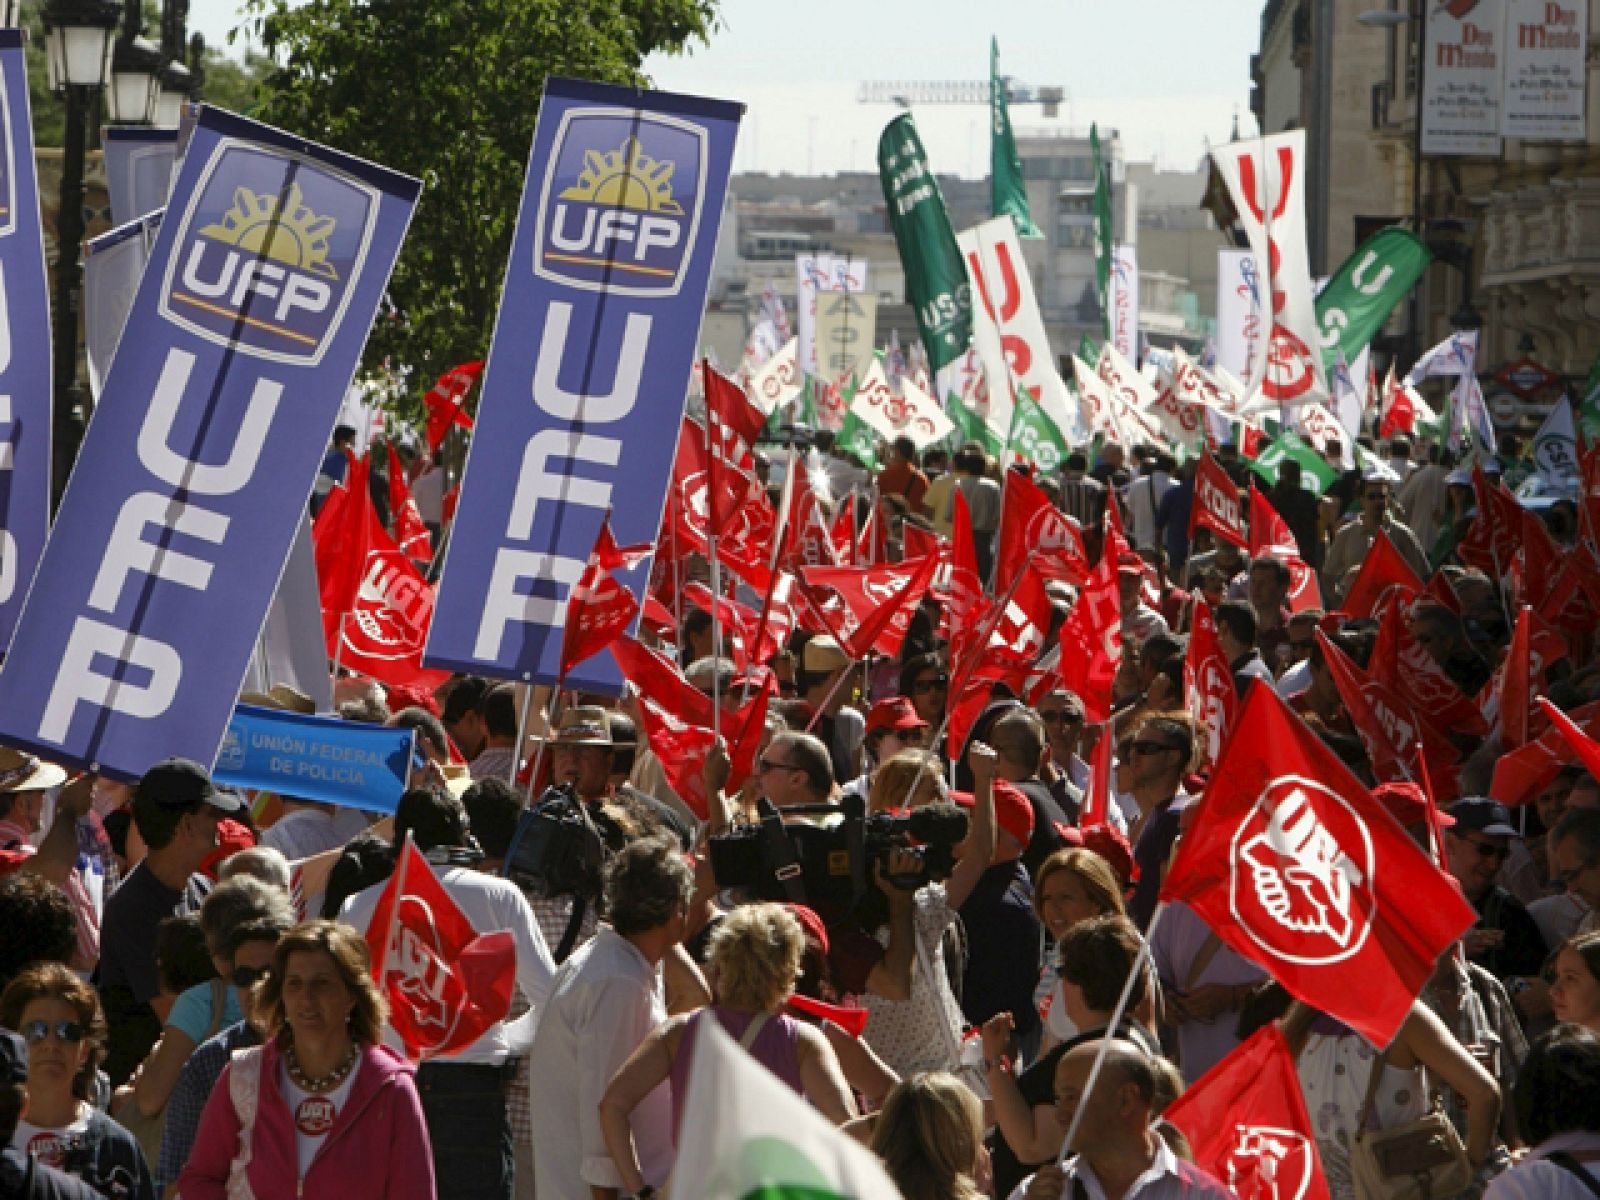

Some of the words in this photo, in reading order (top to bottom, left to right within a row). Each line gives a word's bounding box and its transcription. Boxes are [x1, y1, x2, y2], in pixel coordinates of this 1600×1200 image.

[551, 204, 681, 261] UFP
[182, 240, 331, 321] UFP
[37, 347, 284, 746] UFP
[358, 557, 436, 630] UGT
[251, 733, 306, 755] UNIÓN
[269, 756, 294, 775] DE
